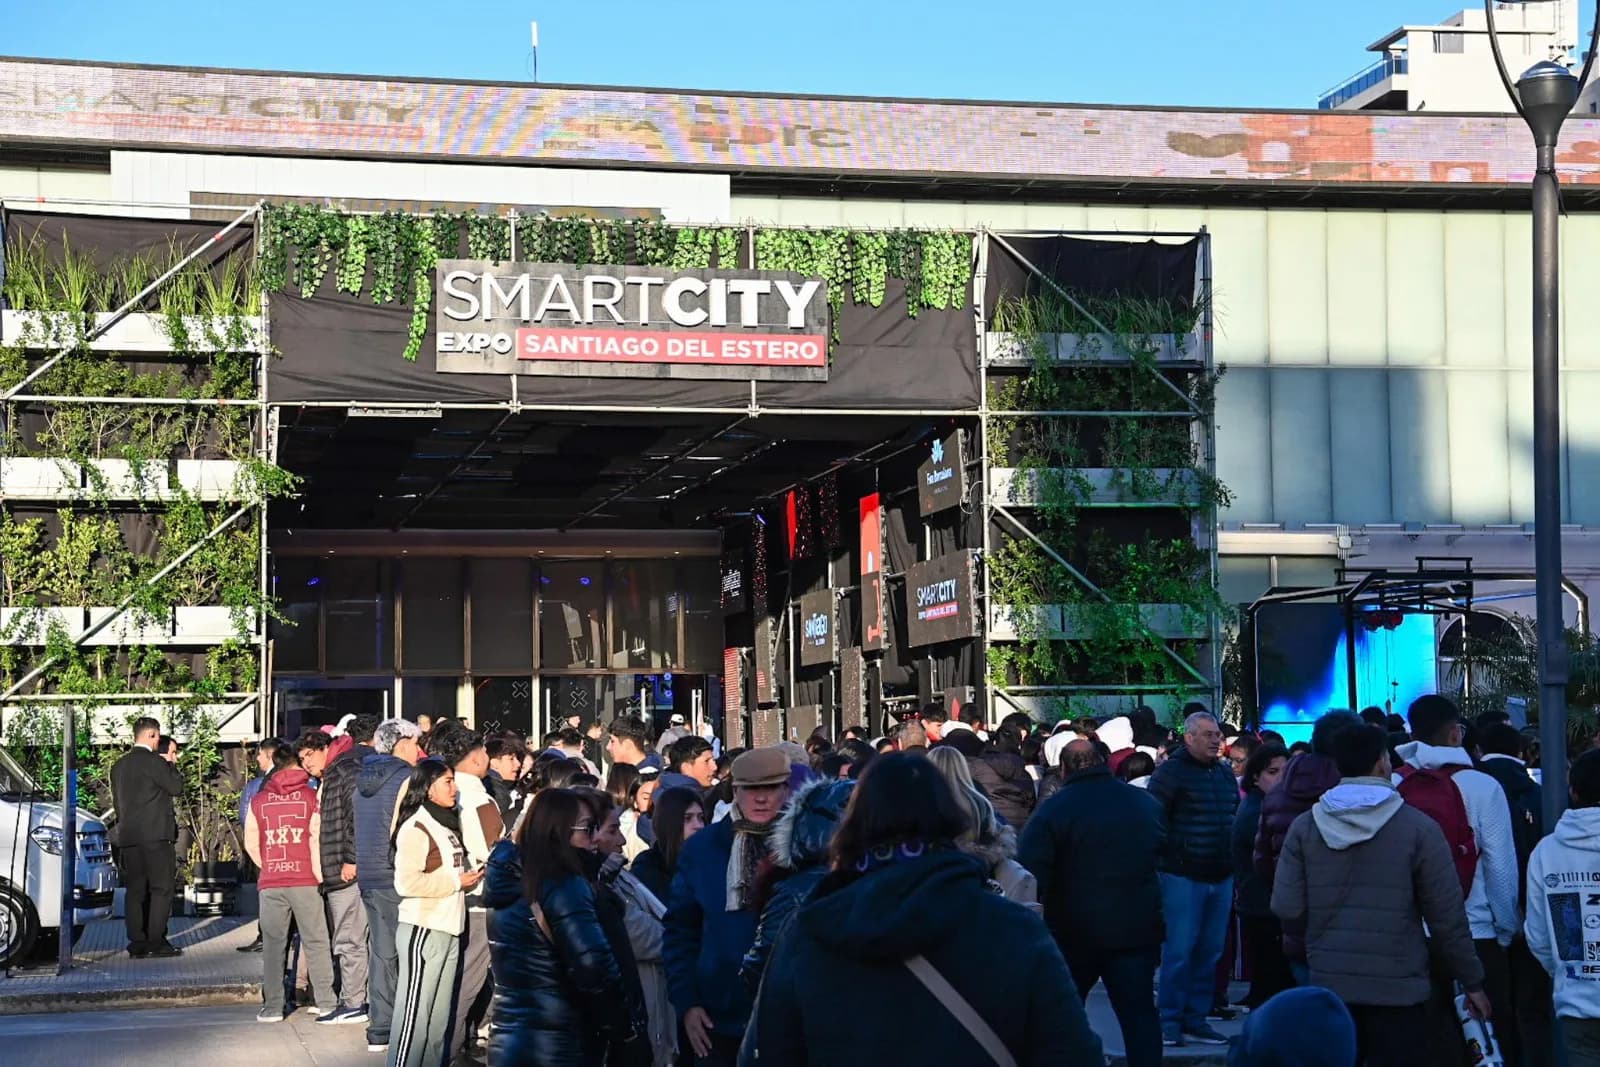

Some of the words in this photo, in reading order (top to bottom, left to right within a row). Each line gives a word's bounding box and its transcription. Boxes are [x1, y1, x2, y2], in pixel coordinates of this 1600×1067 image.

[443, 271, 820, 328] SMARTCITY
[437, 332, 513, 355] EXPO
[524, 334, 659, 357] SANTIAGO
[667, 337, 714, 359] DEL
[721, 340, 819, 361] ESTERO
[917, 578, 956, 607] SMARTCITY
[264, 827, 304, 846] XXV
[268, 861, 302, 873] FABRI
